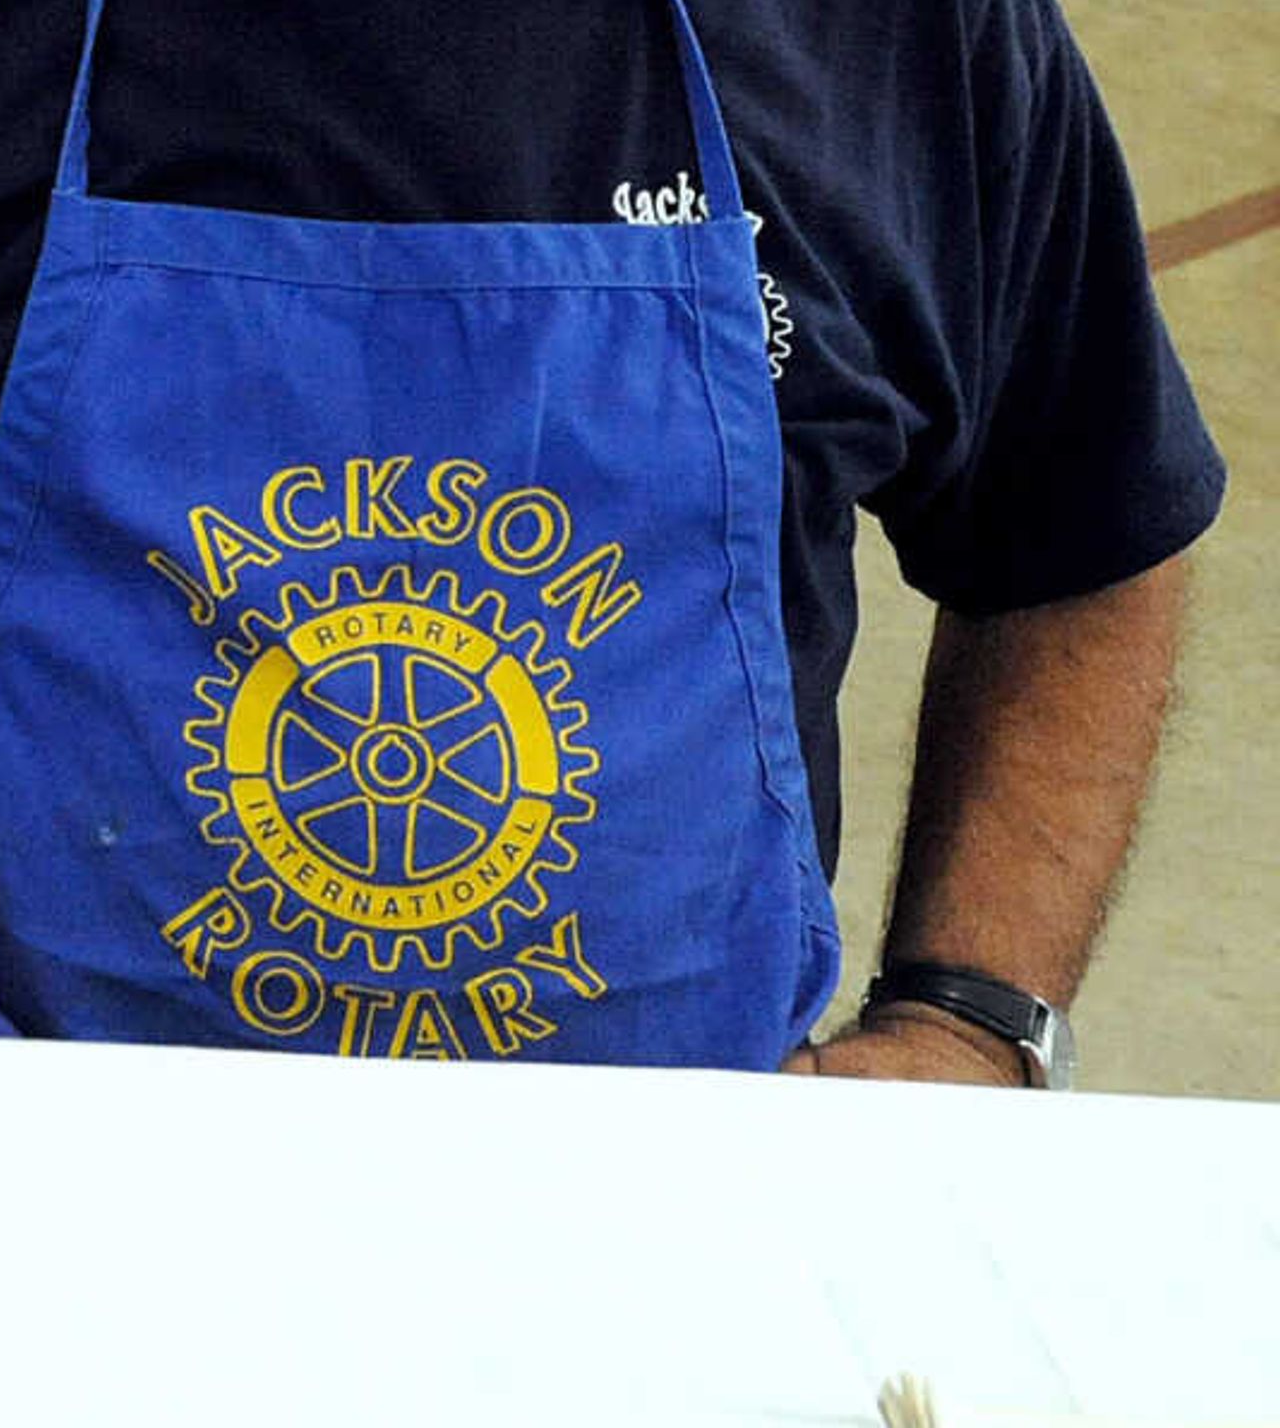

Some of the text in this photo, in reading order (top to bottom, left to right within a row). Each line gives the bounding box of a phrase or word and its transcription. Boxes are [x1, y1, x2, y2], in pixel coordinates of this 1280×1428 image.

[147, 455, 642, 651] JACKSON
[314, 610, 476, 656] ROTARY
[246, 800, 539, 919] INTERNATIONAL
[159, 886, 608, 1062] ROTARY
